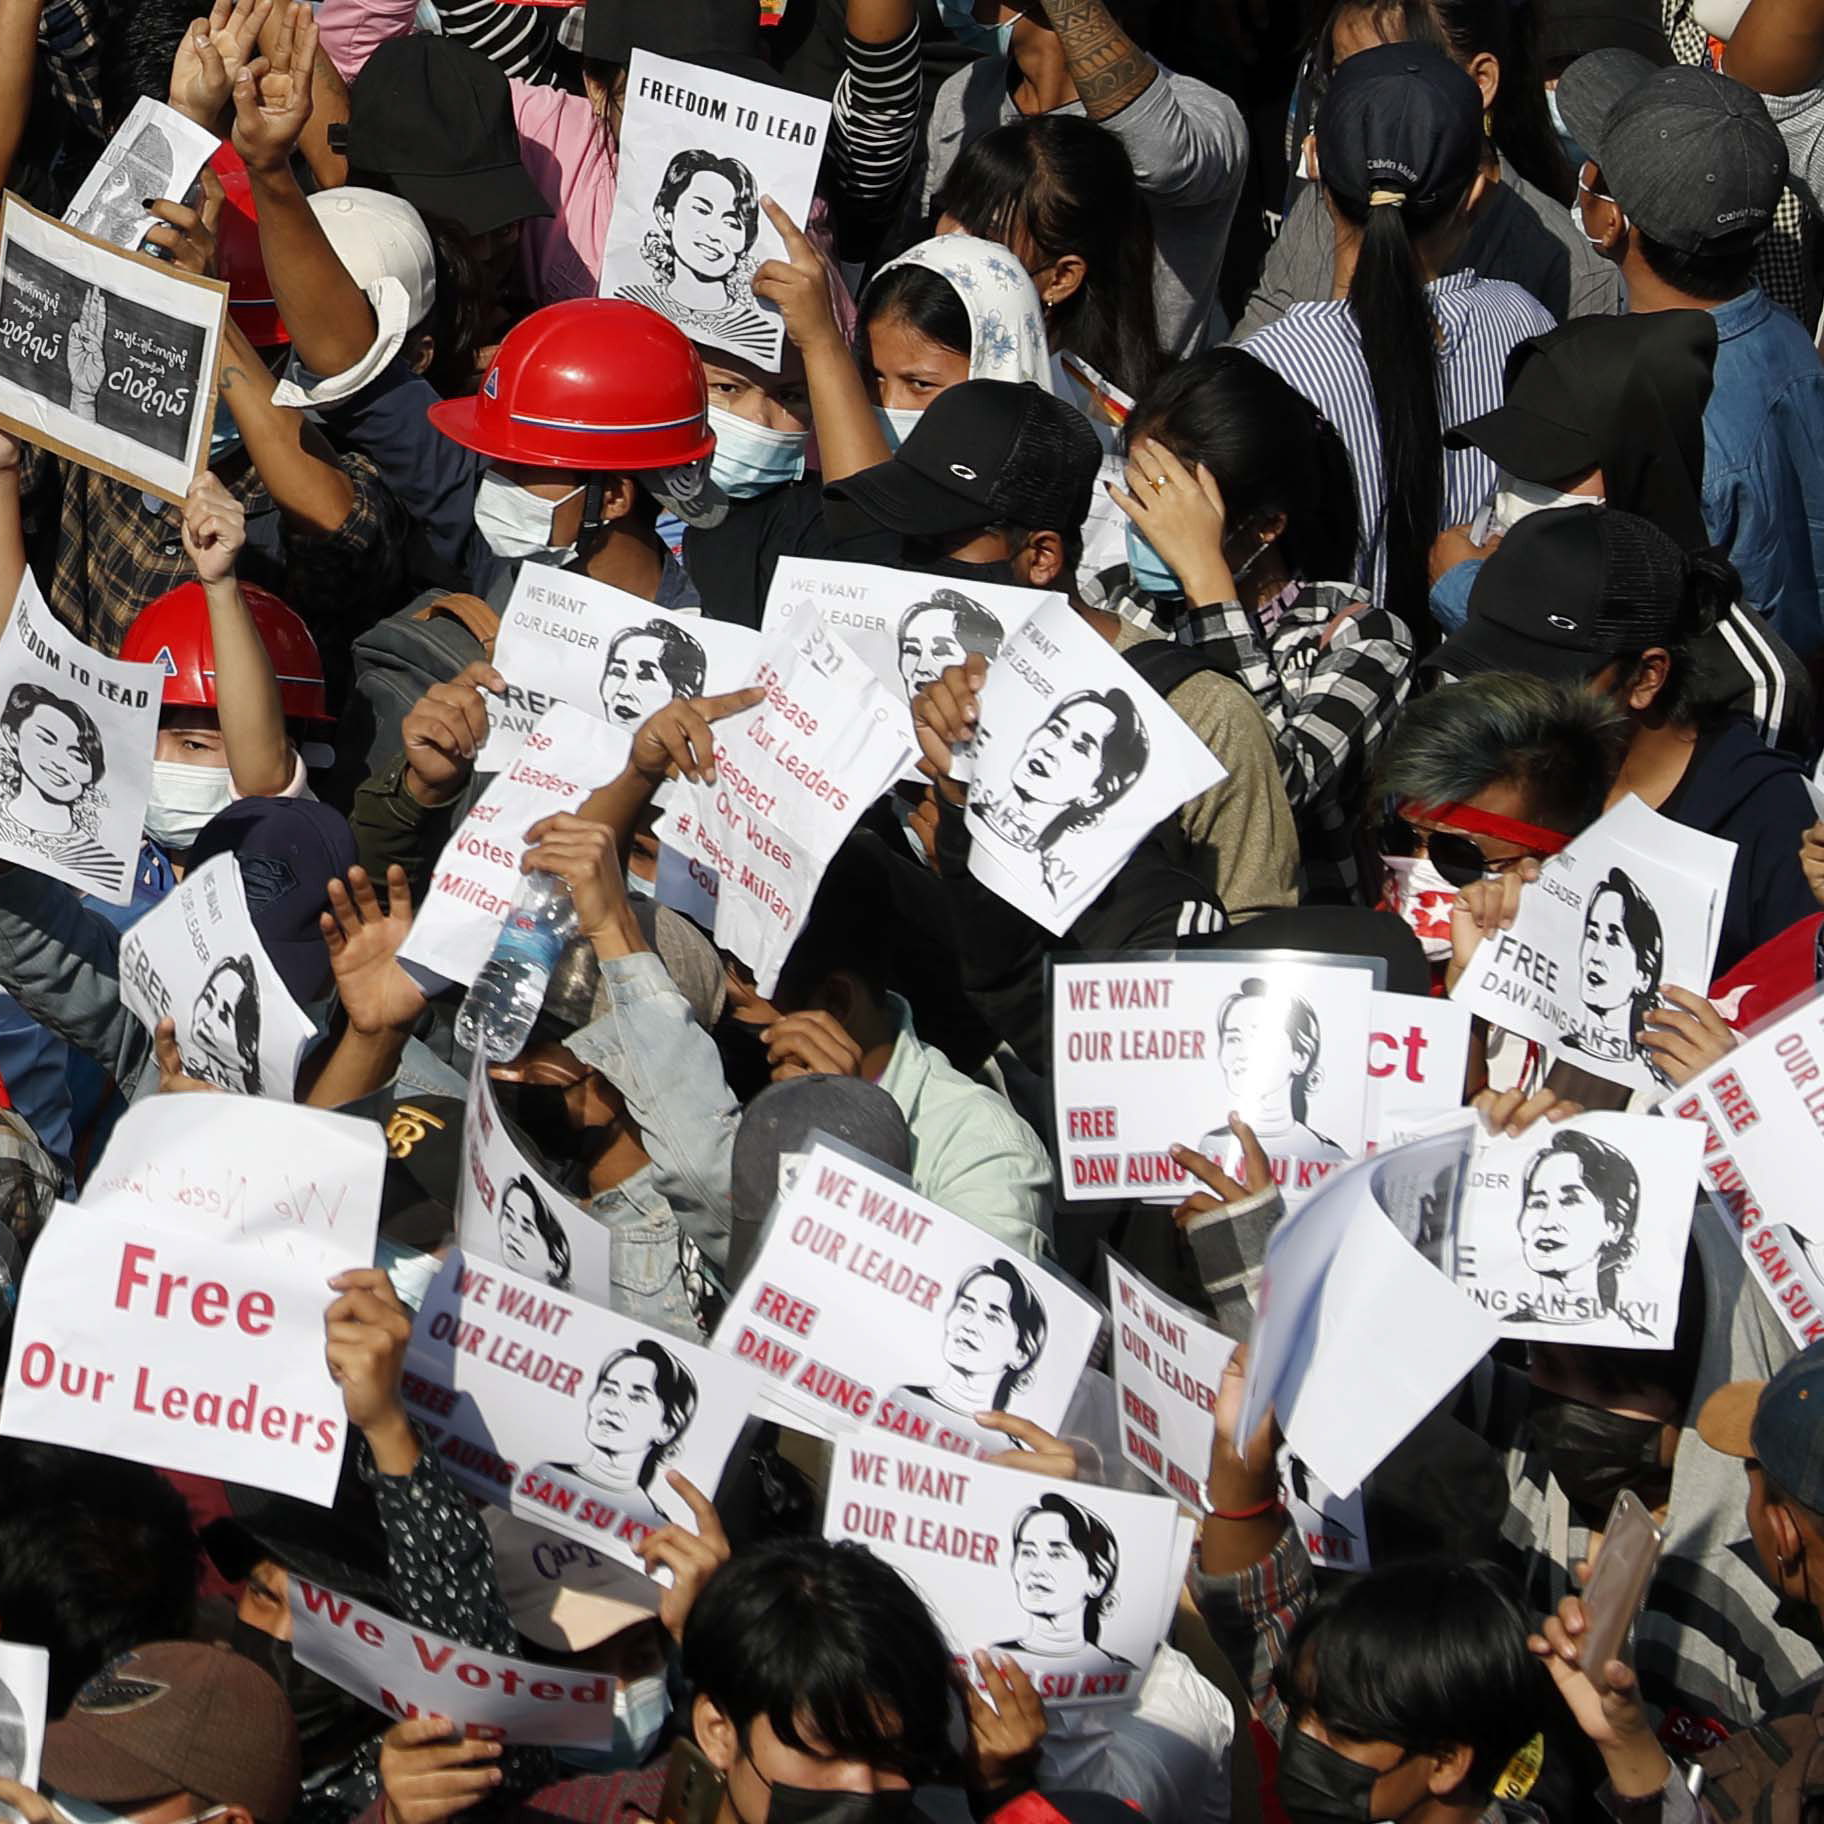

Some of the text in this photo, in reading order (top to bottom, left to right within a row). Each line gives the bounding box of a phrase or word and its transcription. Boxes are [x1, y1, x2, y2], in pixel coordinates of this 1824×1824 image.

[638, 77, 818, 148] FREEDOM TO LEAD
[17, 600, 148, 708] FREEDOM TO LEAD
[1067, 978, 1173, 1010] WE WANT
[1068, 1029, 1205, 1063] OUR LEADER
[1069, 1110, 1117, 1139] FREE
[814, 1169, 932, 1245] WE WANT
[116, 1241, 277, 1338] Free
[790, 1216, 942, 1312] OUR LEADER
[753, 1282, 817, 1336] FREE
[21, 1342, 337, 1454] Our Leaders
[850, 1449, 971, 1507] WE WANT
[843, 1501, 999, 1567] OUR LEADER
[299, 1581, 609, 1707] We Voted
